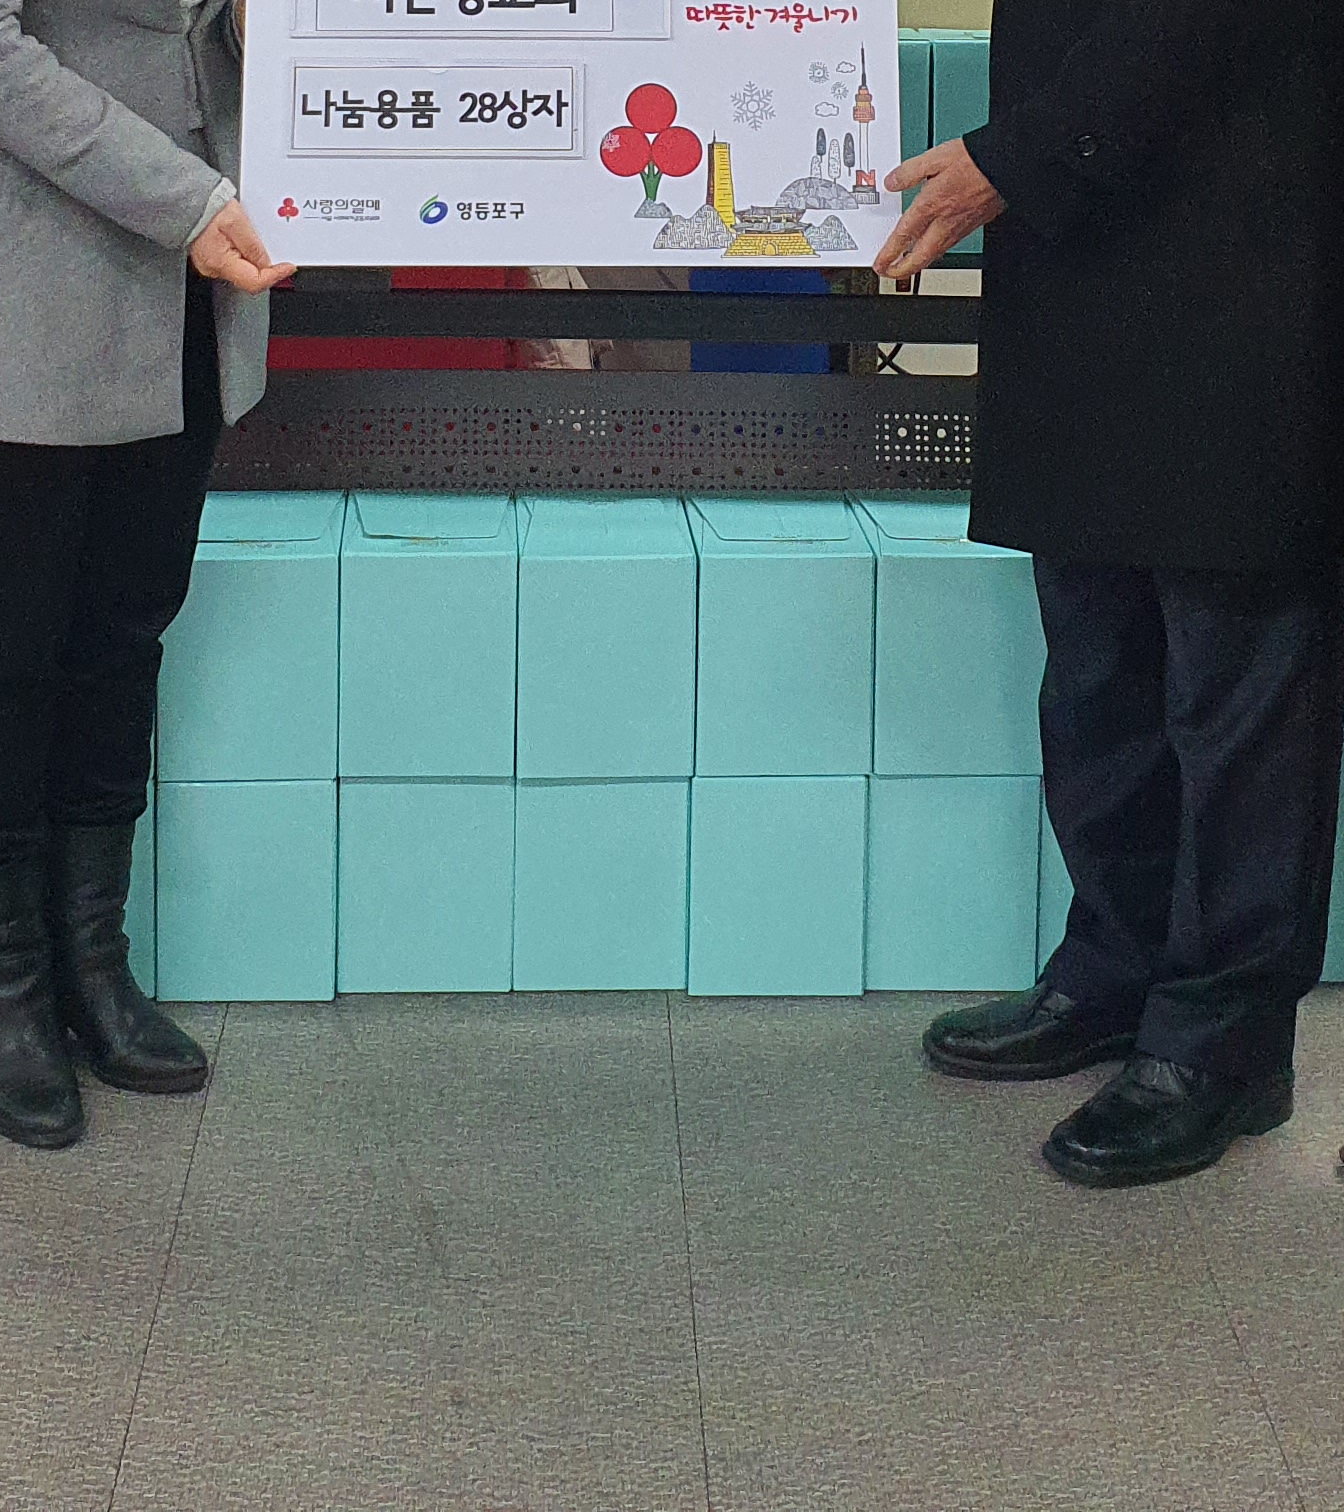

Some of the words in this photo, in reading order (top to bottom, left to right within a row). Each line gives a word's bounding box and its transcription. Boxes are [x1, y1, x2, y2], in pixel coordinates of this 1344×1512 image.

[685, 3, 762, 31] 따뜻한
[763, 2, 858, 34] 겨울나기
[301, 89, 442, 129] 나눔용품
[458, 89, 570, 129] 28상자
[302, 198, 381, 215] 사랑의열매
[456, 201, 525, 221] 영등포구
